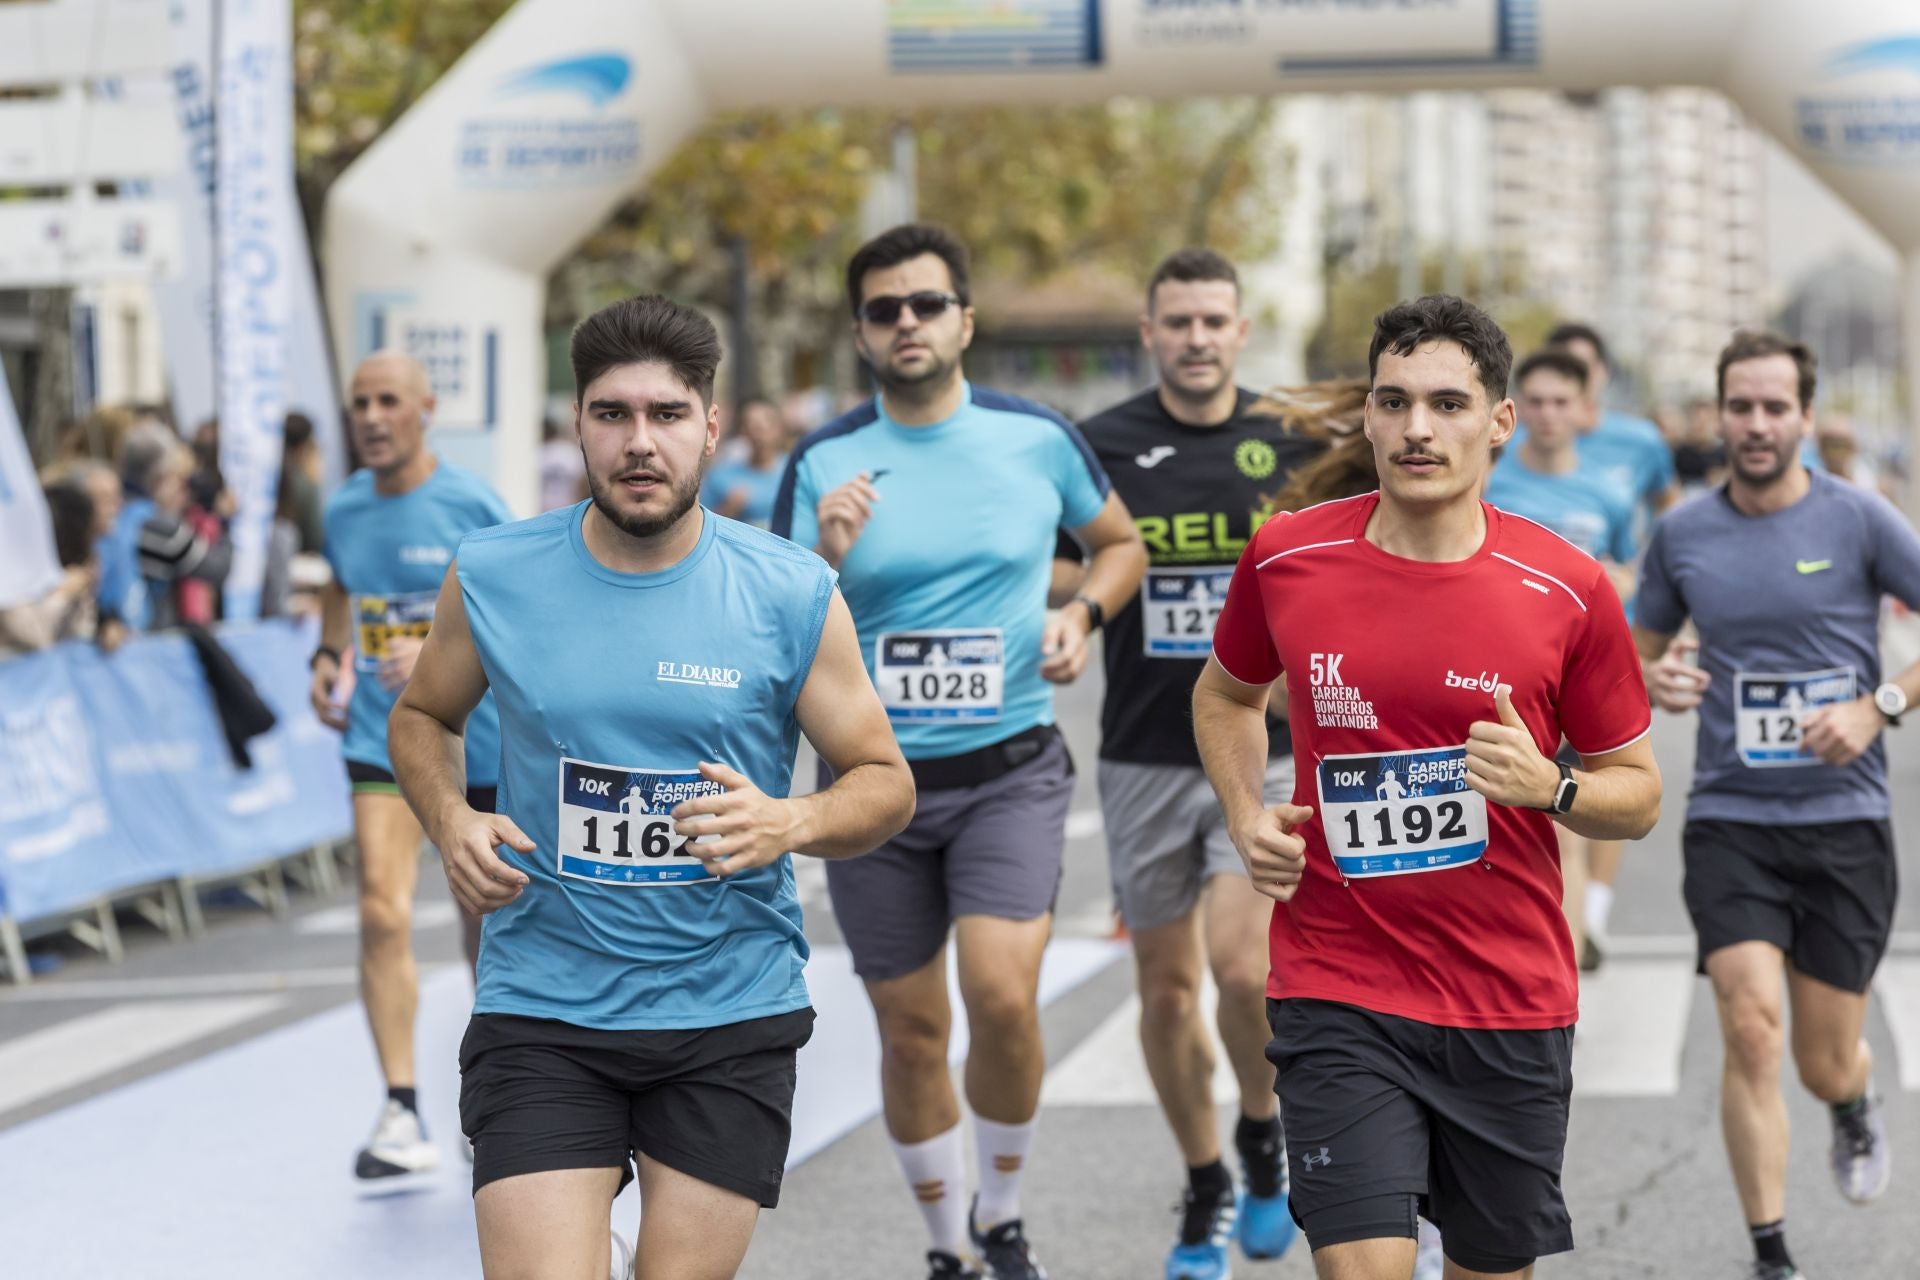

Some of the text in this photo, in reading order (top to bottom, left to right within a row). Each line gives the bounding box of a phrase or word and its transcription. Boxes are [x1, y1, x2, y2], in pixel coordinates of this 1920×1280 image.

[657, 661, 742, 683] EL DIARIO
[1309, 653, 1344, 686] 5K
[901, 673, 987, 701] 1028
[1311, 686, 1361, 701] CARRERA
[1314, 700, 1374, 716] BOMBEROS
[1316, 713, 1379, 730] SANTANDER
[1758, 716, 1797, 742] 12
[1408, 758, 1467, 774] CARRER
[1333, 770, 1367, 787] 10K
[1407, 769, 1471, 785] POPULA
[578, 777, 613, 797] 10K
[654, 780, 720, 794] CARRERA
[1344, 800, 1467, 848] 1192
